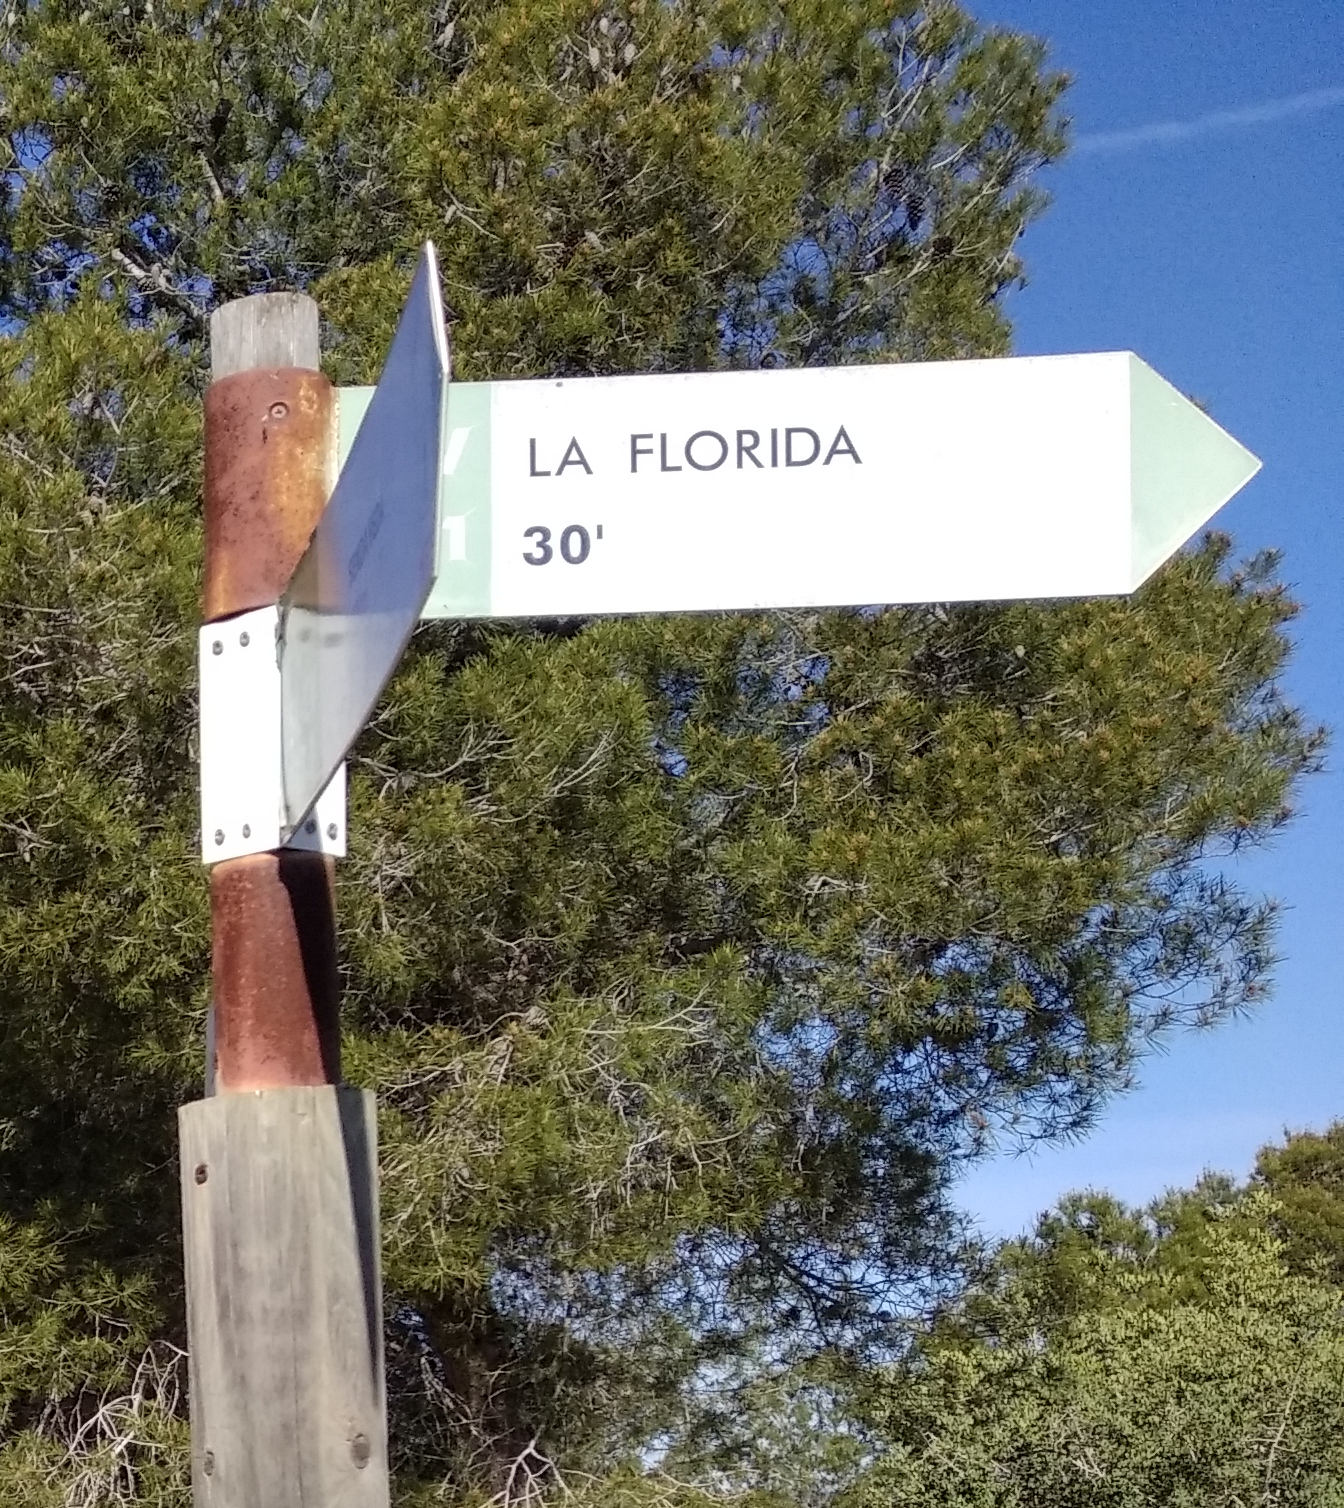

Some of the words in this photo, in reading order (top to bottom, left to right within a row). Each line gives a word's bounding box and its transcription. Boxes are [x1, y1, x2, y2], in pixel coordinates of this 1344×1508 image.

[529, 435, 594, 477] LA
[630, 424, 863, 473] FLORIDA
[522, 523, 604, 566] 30'
